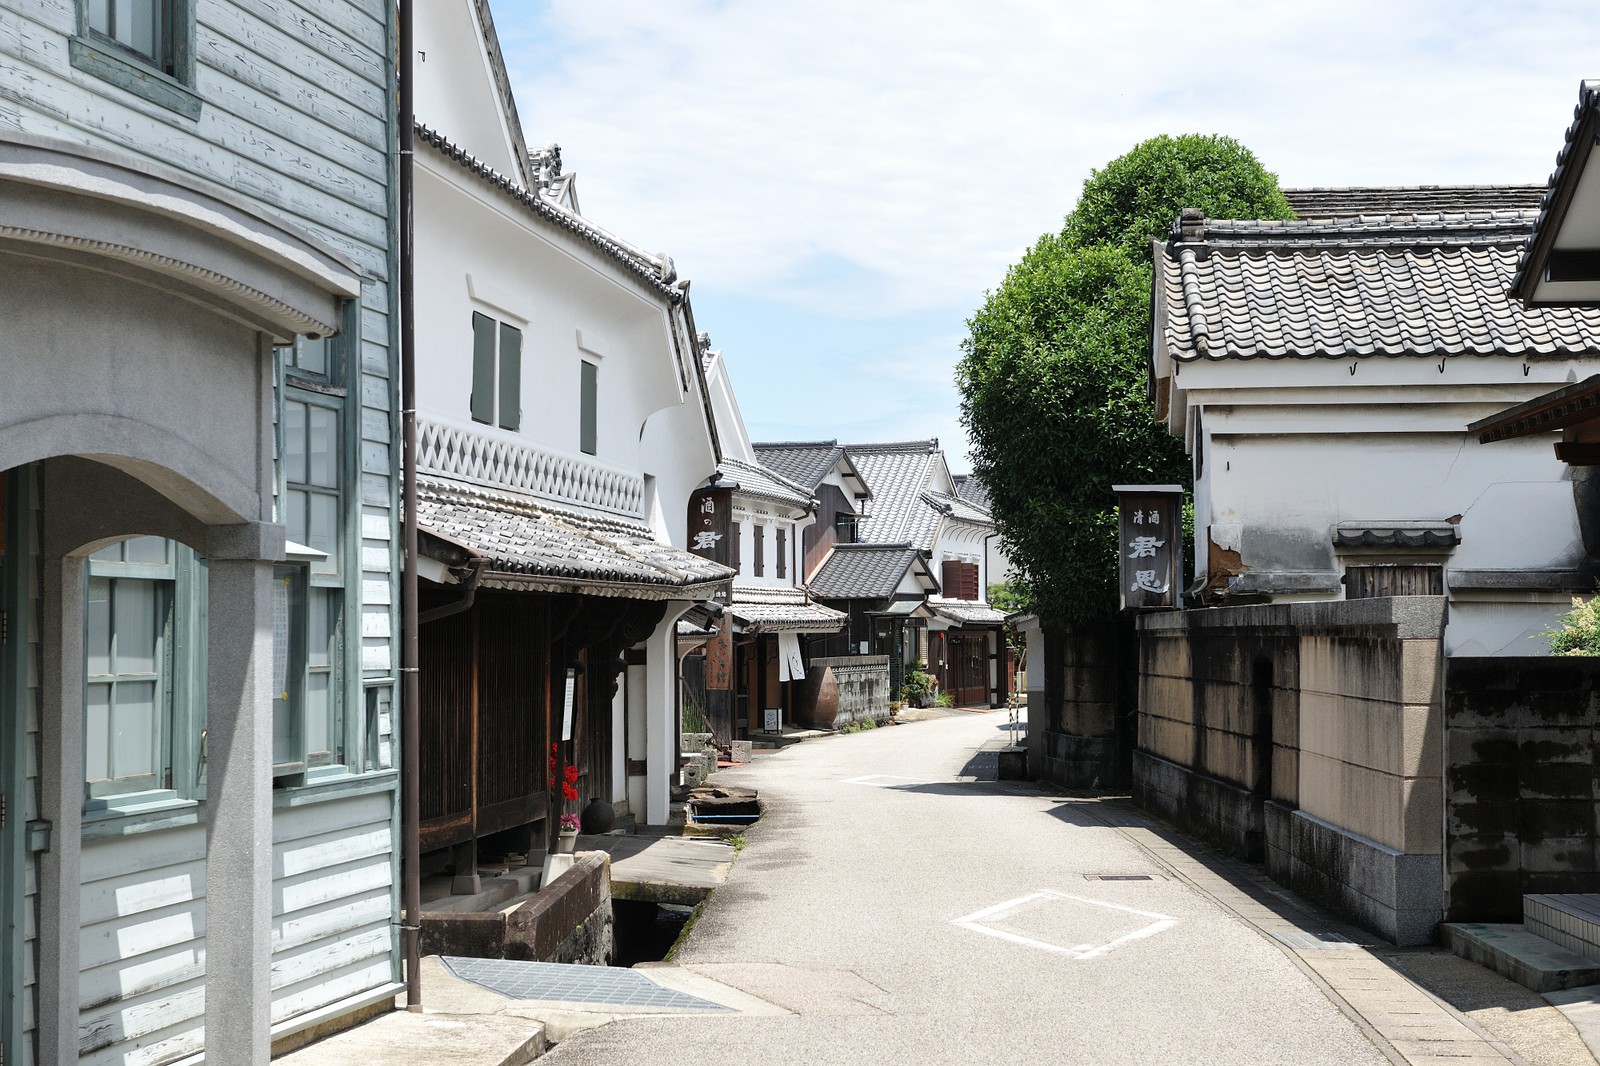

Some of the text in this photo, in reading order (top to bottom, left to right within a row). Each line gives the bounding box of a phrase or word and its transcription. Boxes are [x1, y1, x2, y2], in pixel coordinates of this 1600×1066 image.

[690, 497, 724, 550] 酒の君
[1133, 509, 1160, 525] 清酒
